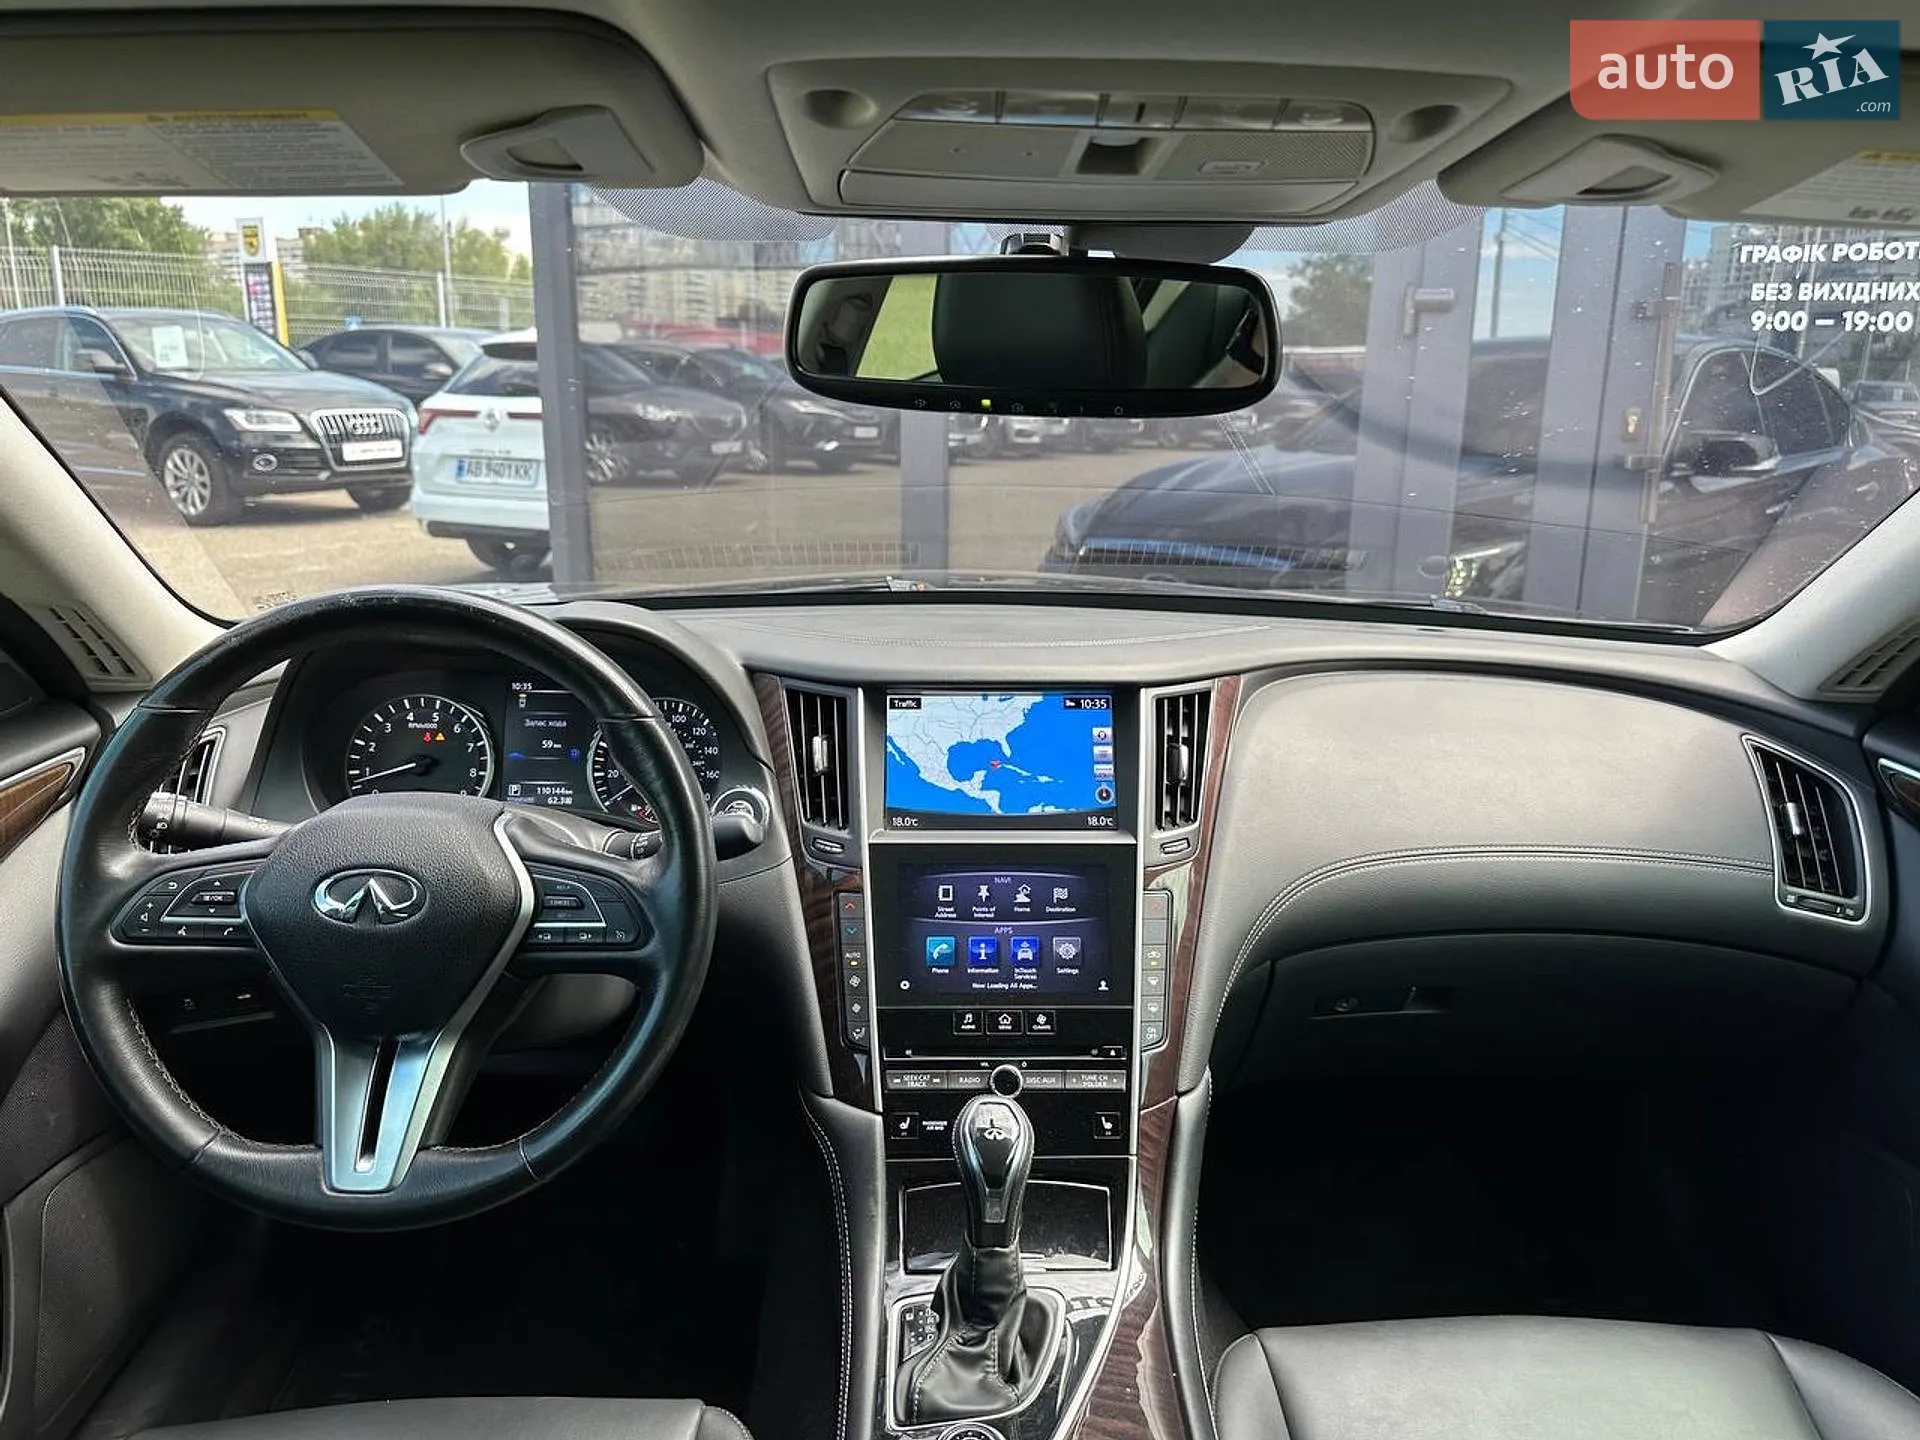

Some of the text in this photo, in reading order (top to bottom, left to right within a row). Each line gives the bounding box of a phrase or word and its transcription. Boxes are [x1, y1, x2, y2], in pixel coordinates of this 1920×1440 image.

[1739, 241, 1920, 263] ГРАФІК РОБОТ
[1751, 282, 1920, 304] БЕЗ ВИХІДНИХ
[1751, 310, 1808, 332] 9:00
[1841, 310, 1914, 333] 19:00
[893, 700, 917, 708] Traffic
[1080, 699, 1107, 710] 10:35
[406, 712, 414, 721] 4
[432, 712, 440, 722] 5
[671, 715, 687, 723] 100
[384, 723, 392, 734] 3
[453, 723, 461, 734] 6
[692, 727, 707, 736] 120
[368, 742, 376, 753] 2
[467, 742, 475, 753] 7
[704, 747, 719, 755] 140
[469, 768, 477, 778] 8
[607, 770, 619, 778] 20
[994, 876, 1011, 884] NAVI
[959, 1076, 981, 1084] RADIO
